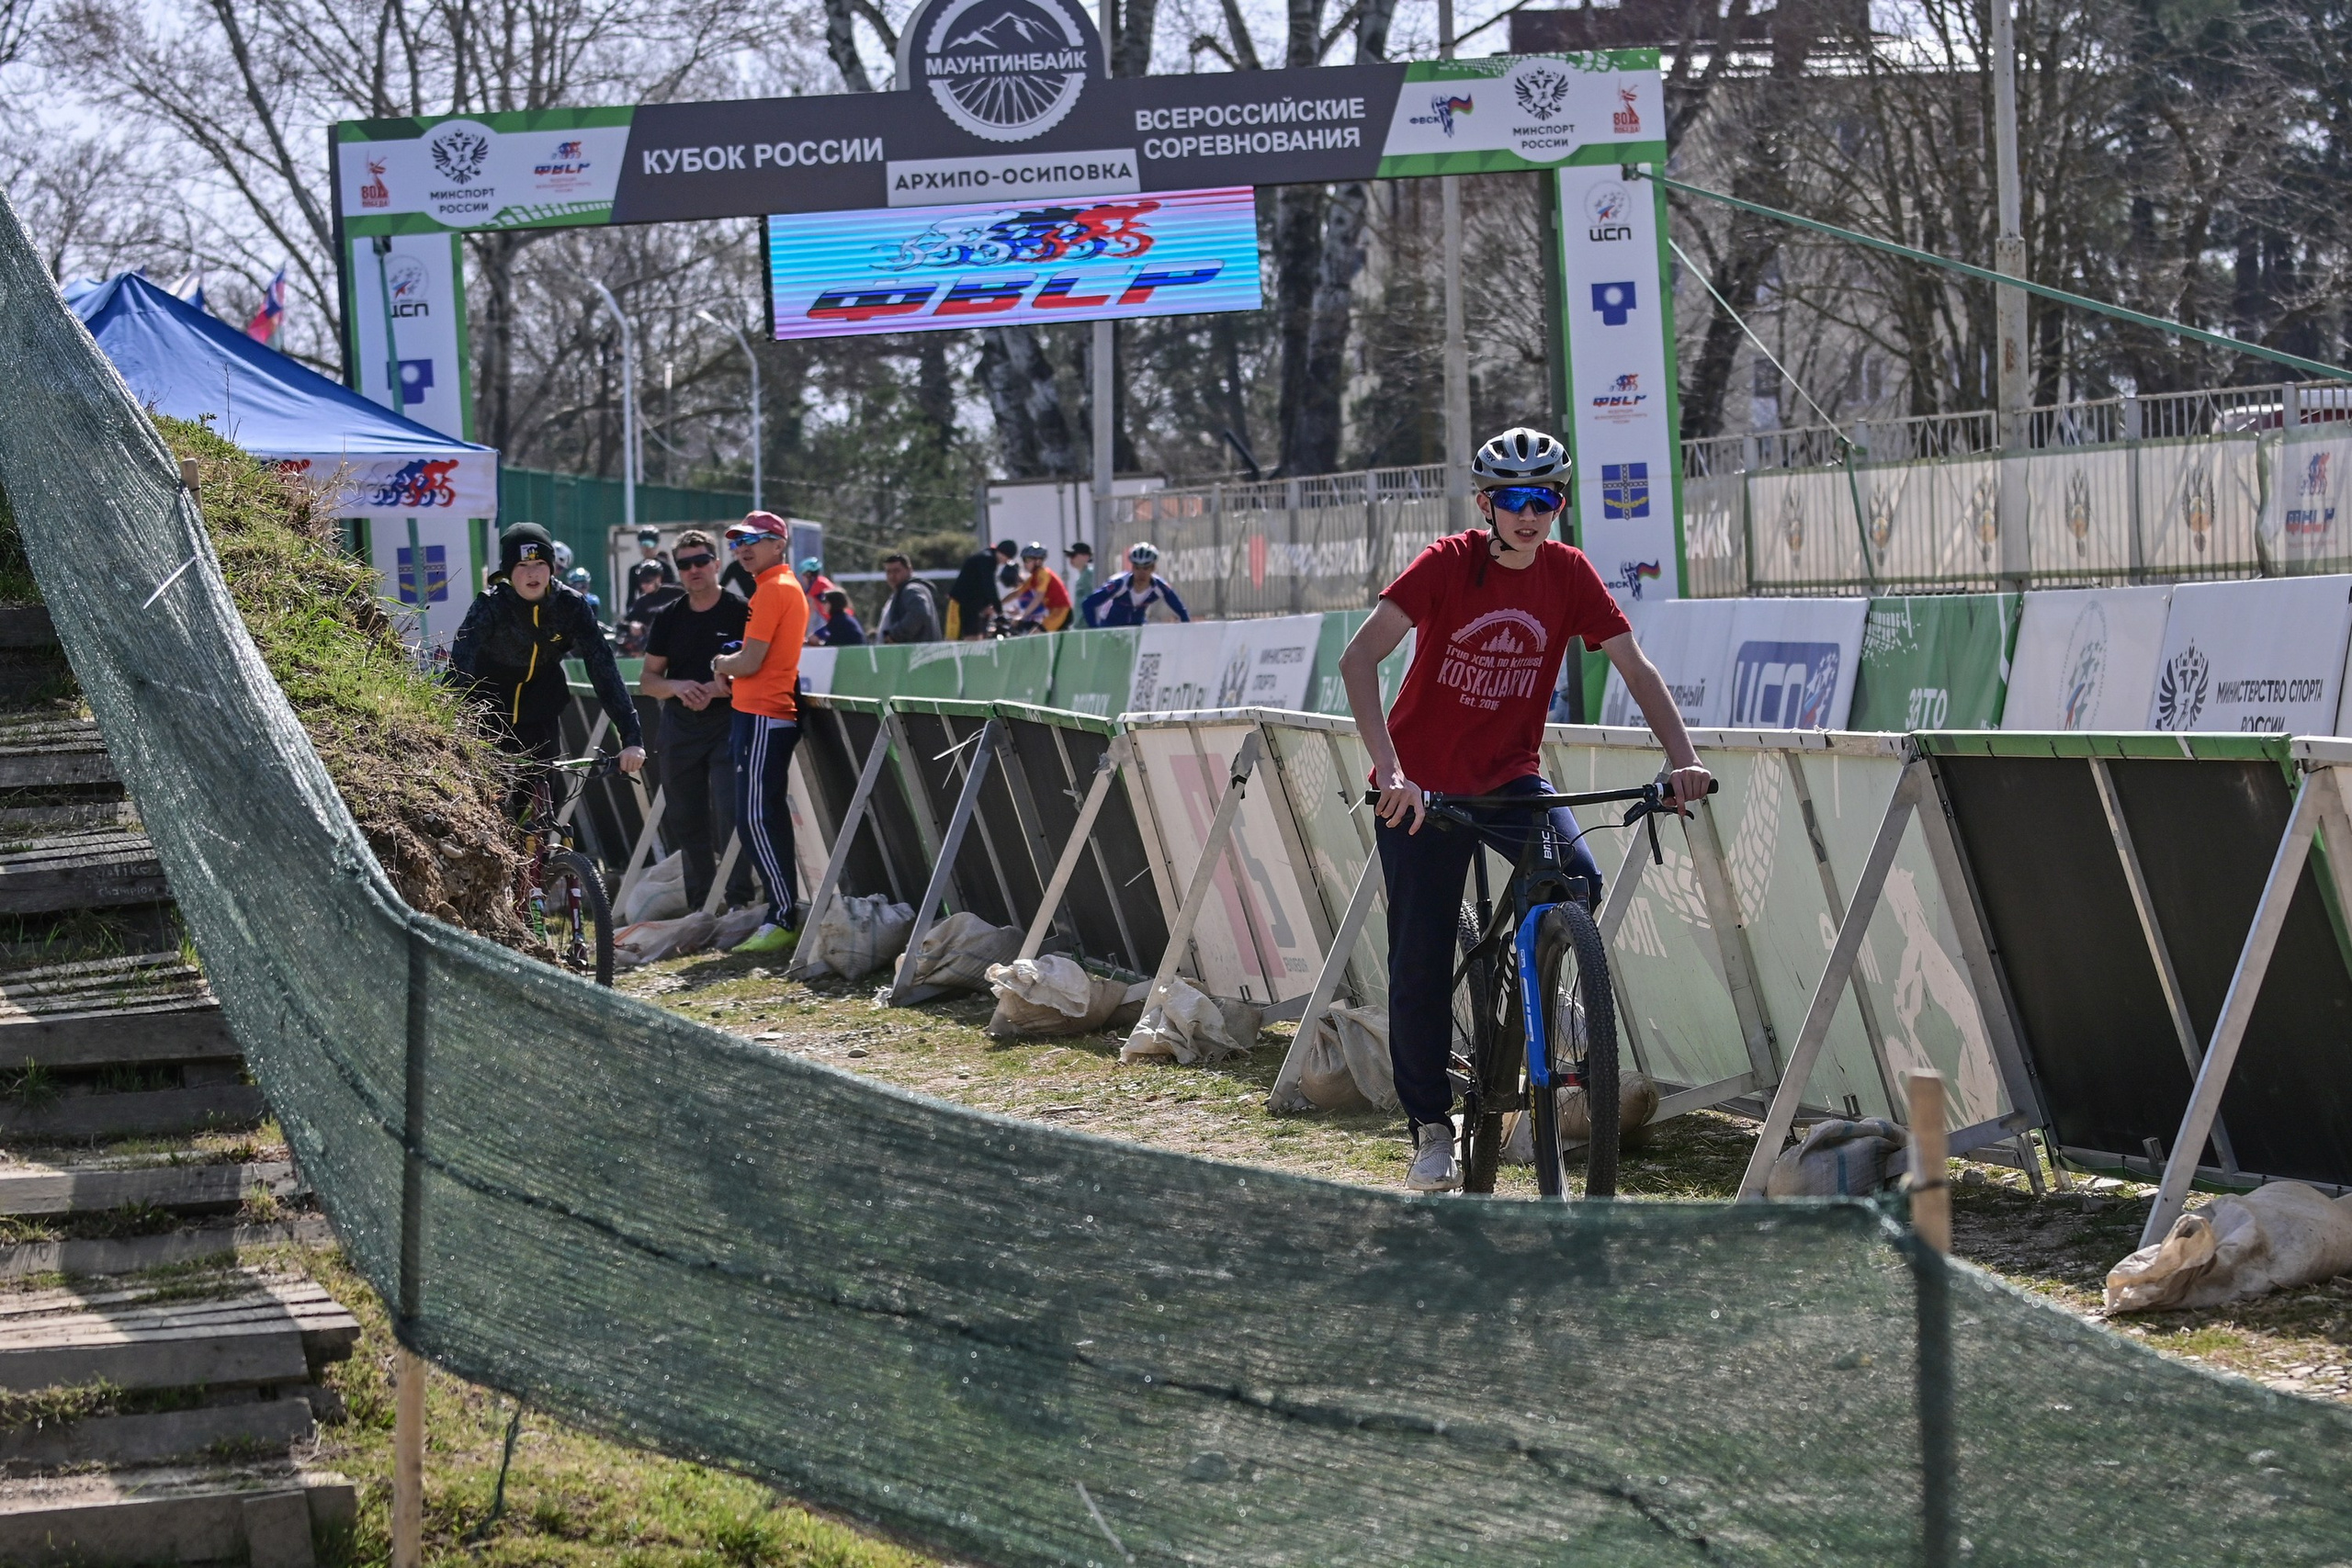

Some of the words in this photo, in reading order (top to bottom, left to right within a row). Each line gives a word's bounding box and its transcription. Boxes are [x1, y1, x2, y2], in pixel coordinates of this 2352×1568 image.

[925, 48, 1088, 75] МАУНТИНБАЙК
[1136, 96, 1366, 131] ВСЕРОССИЙСКИЕ
[1409, 116, 1441, 126] ФВСК
[1144, 127, 1361, 160] СОРЕВНОВАНИЯ
[1512, 125, 1576, 137] МИНСПОРТ
[643, 145, 746, 175] КУБОК
[753, 137, 885, 169] РОССИИ
[1521, 138, 1569, 150] РОССИИ
[895, 162, 1133, 191] АРХИПО-ОСИПОВКА
[430, 187, 495, 201] МИНСПОРТ
[439, 202, 490, 214] РОССИИ
[1589, 227, 1632, 242] ЦСП
[1445, 644, 1470, 660] True
[1497, 658, 1510, 668] no
[1437, 658, 1538, 698] KOSKIJÄRVI
[2216, 679, 2287, 705] МИНИСТЕРСТВО
[2289, 679, 2324, 704] СПОРТА
[2240, 716, 2285, 732] РОССИИ
[1541, 829, 1553, 860] BMC
